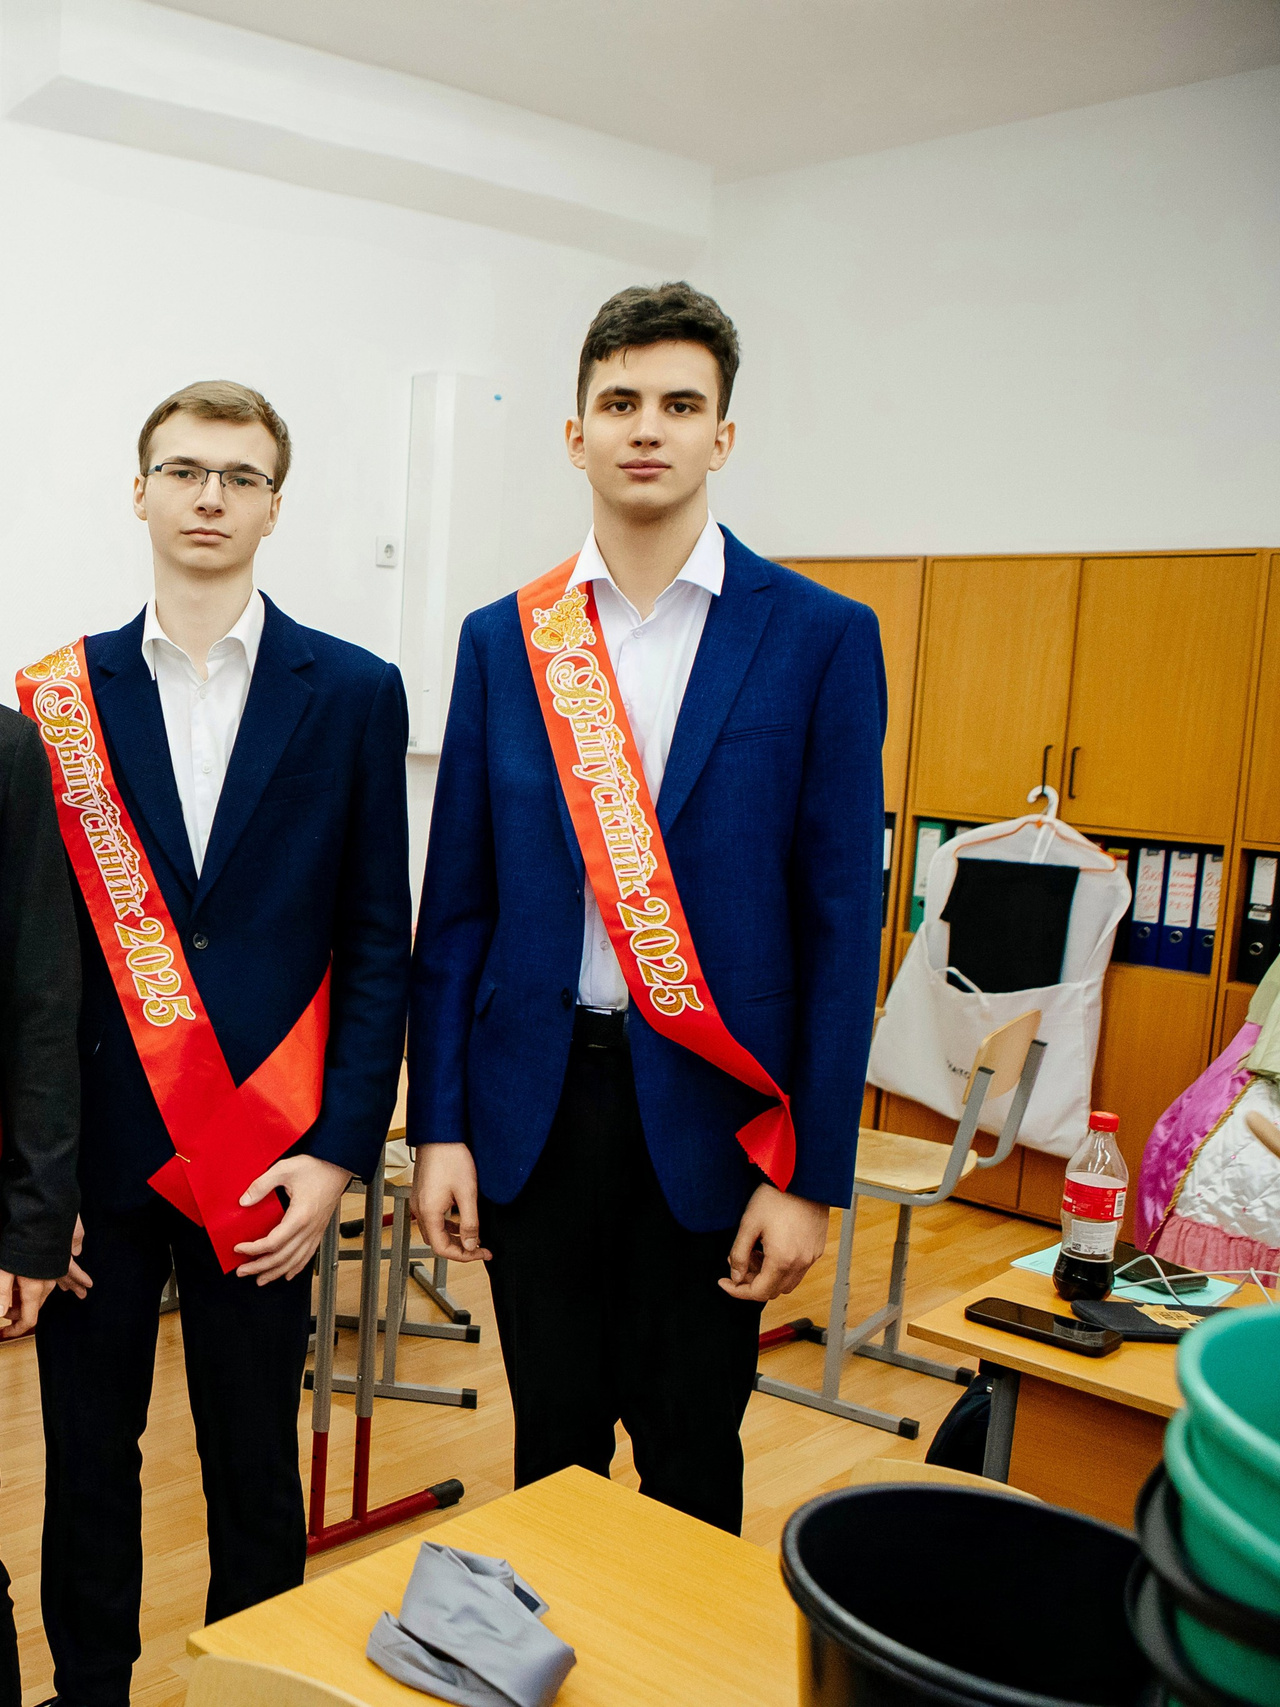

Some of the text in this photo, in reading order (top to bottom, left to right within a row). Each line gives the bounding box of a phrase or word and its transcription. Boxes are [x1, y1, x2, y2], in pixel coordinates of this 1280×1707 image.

[32, 679, 196, 1028] Выпускник 2025
[545, 649, 705, 1017] Выпускник 2025
